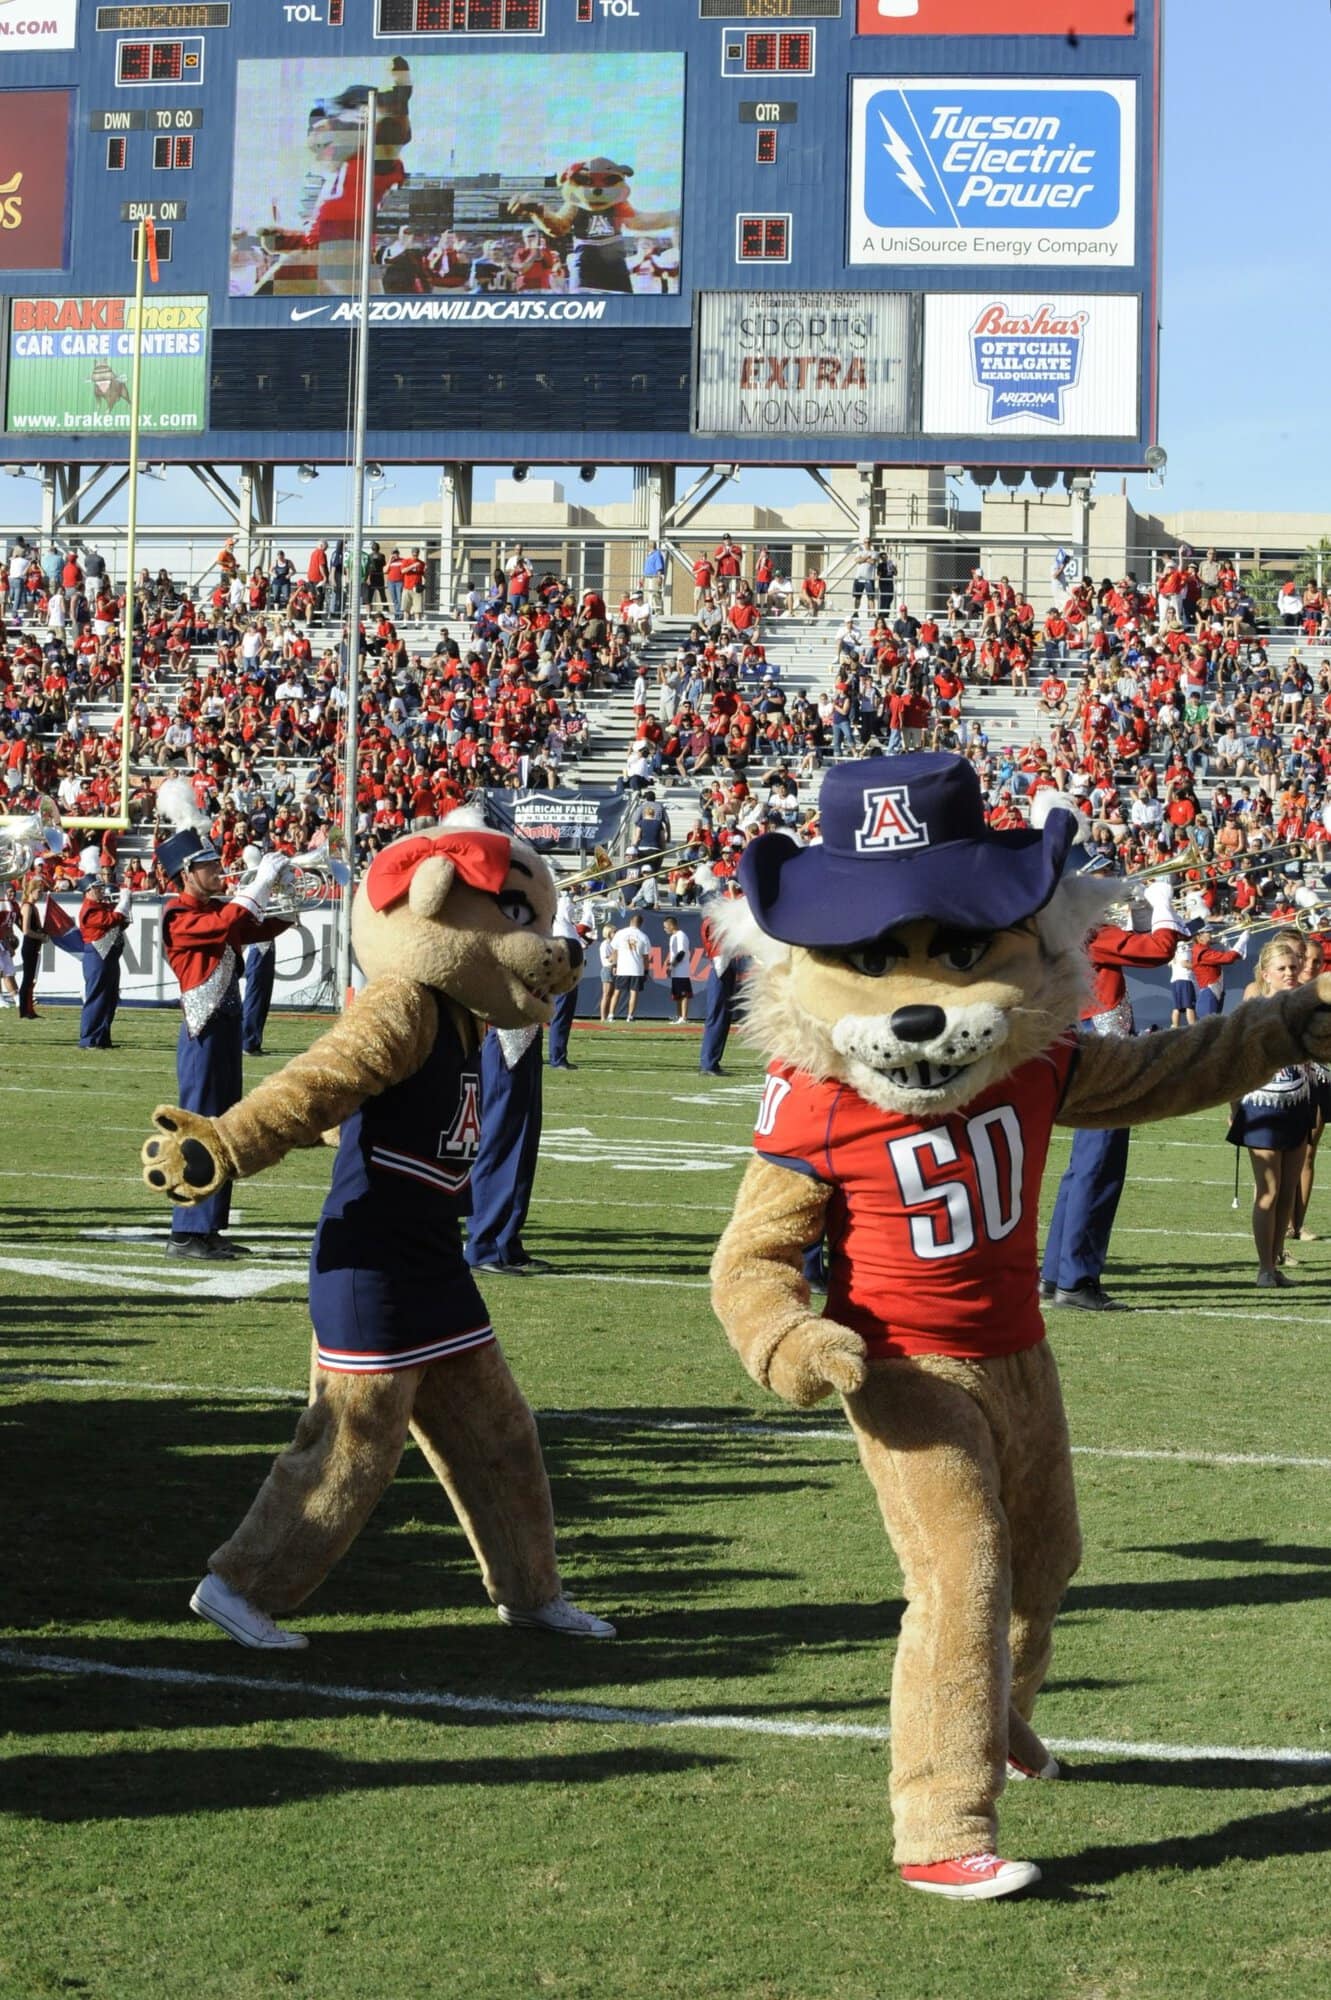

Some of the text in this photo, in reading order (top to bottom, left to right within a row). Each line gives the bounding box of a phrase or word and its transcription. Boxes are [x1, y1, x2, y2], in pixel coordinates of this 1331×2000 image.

[119, 7, 208, 28] ARIZONA
[283, 5, 323, 21] TOL
[599, 0, 640, 16] TOL
[122, 44, 181, 79] 34
[747, 34, 810, 69] 00
[104, 112, 130, 129] DWN
[157, 110, 193, 128] TO GO
[755, 103, 780, 121] QTR
[929, 106, 1061, 140] Tucson
[166, 136, 192, 167] 10
[757, 131, 776, 161] 3
[942, 141, 1096, 174] Electric
[957, 175, 1094, 208] Power
[129, 202, 177, 220] BALL ON
[743, 220, 785, 256] 25
[863, 238, 1118, 256] A UniSource Energy Company
[13, 299, 125, 331] BRAKE
[330, 300, 606, 320] ARZONAWILDCATS.COM
[975, 306, 1085, 335] Bashas'
[16, 335, 54, 355] CAR
[61, 334, 110, 355] CARE
[739, 318, 868, 350] SPORTS
[982, 342, 1072, 355] OFFICIAL
[740, 356, 868, 390] EXTRA
[981, 358, 1071, 370] TAILGATE
[981, 372, 1071, 381] HEADQUARTERS
[996, 392, 1056, 403] ARIZONA
[13, 412, 197, 428] www.brakemx.com
[740, 400, 868, 425] MONDAYS
[515, 805, 598, 814] AMERICAN FAMILY
[855, 785, 930, 852] A
[437, 1073, 482, 1161] A
[754, 1073, 792, 1136] 0
[886, 1103, 1025, 1260] 50
